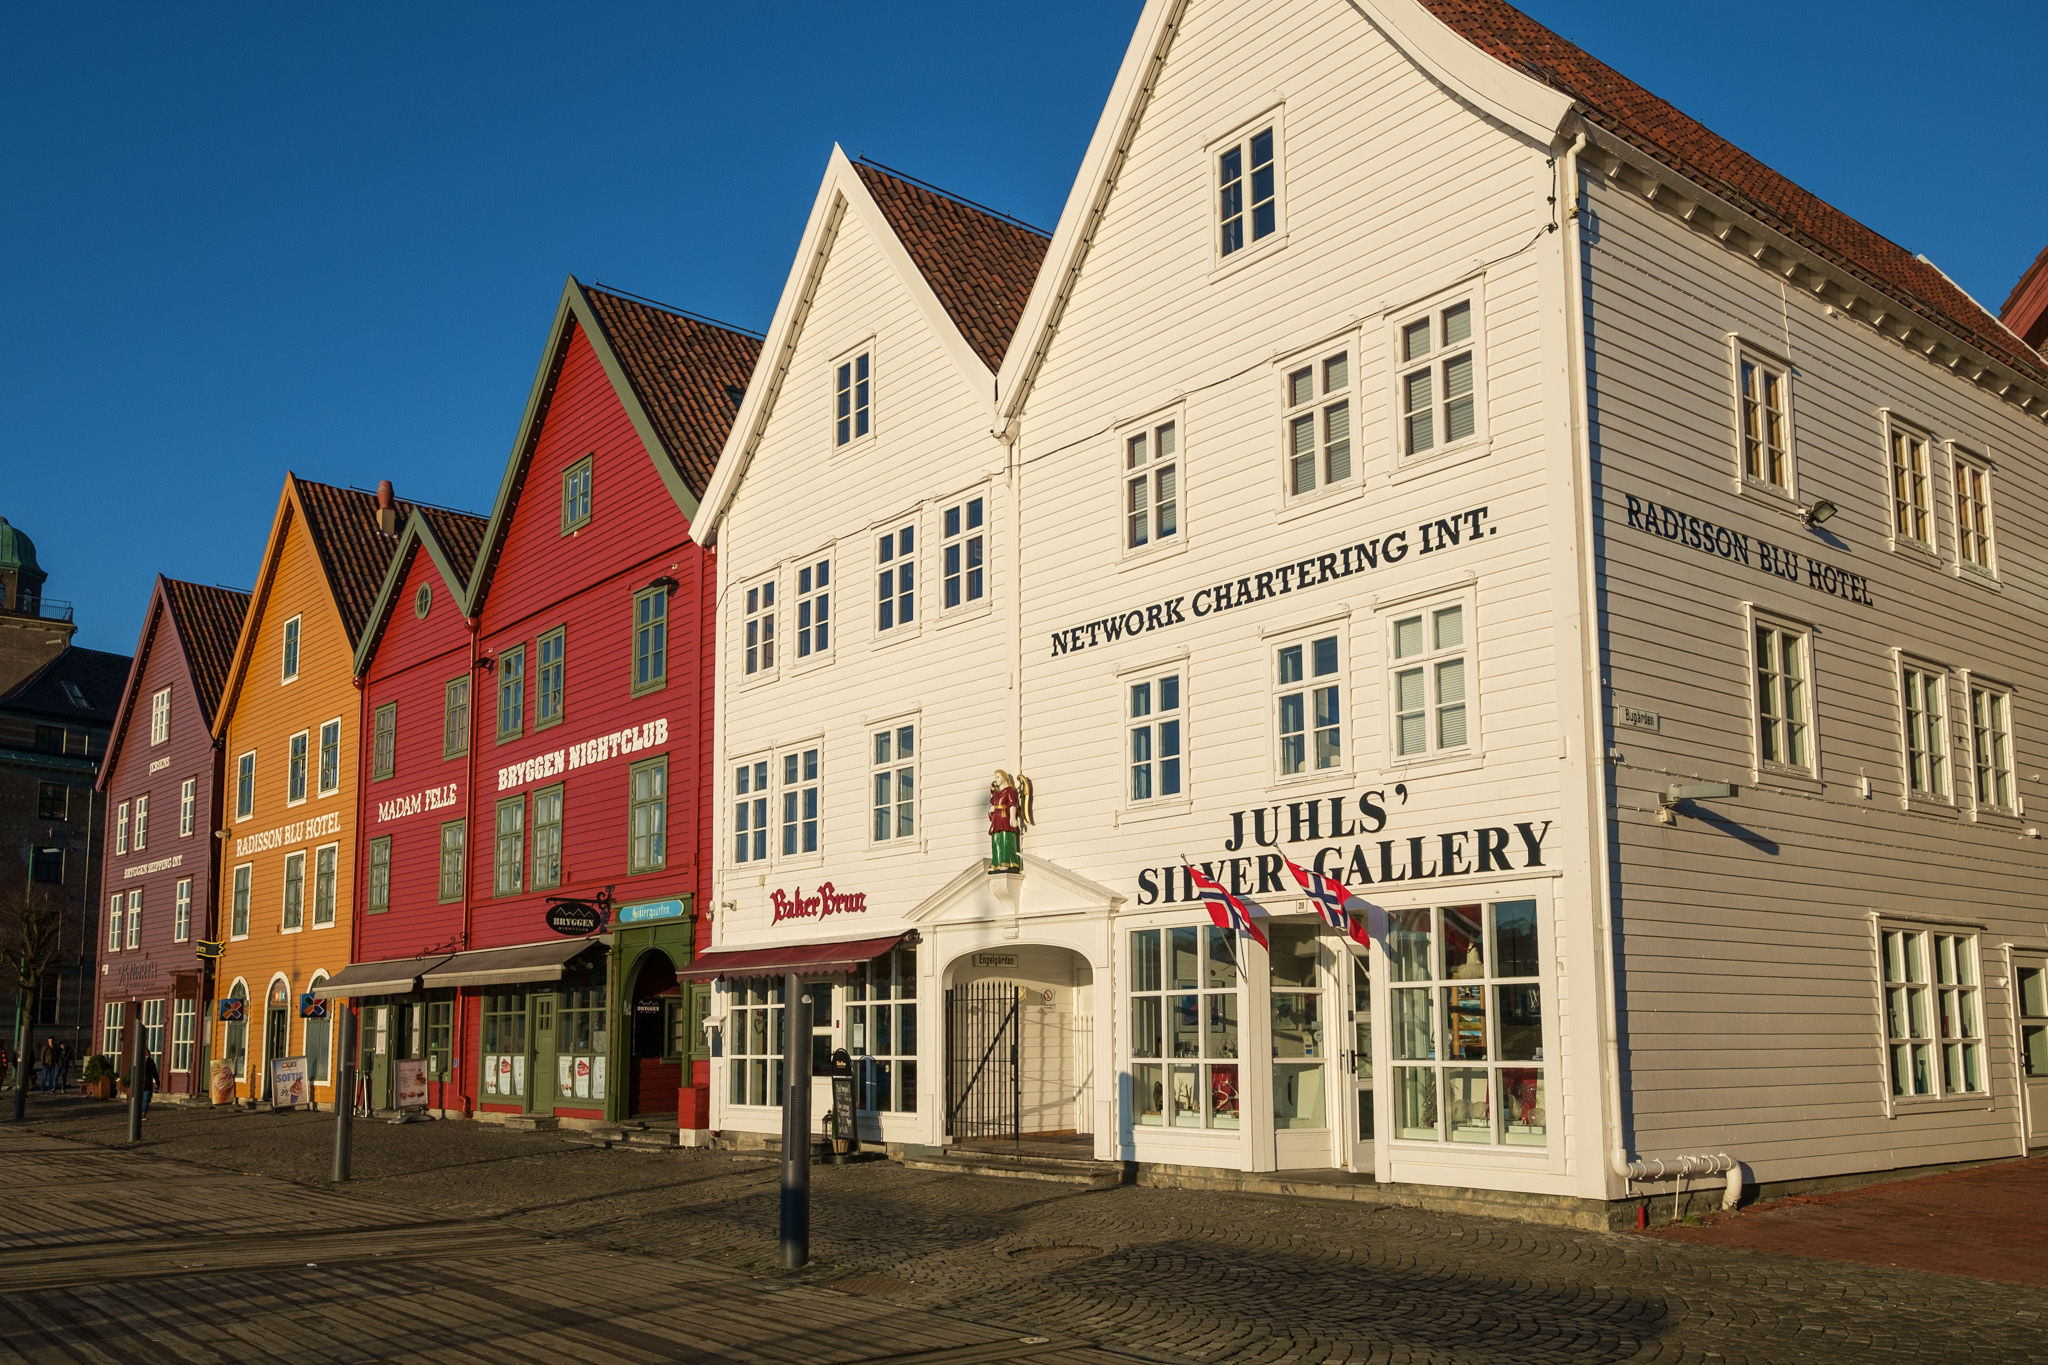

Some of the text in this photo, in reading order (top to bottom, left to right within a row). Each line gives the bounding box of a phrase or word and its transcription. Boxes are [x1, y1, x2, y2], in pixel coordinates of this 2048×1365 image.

[1625, 493, 1874, 607] RADISSON BLU HOTEL
[1050, 506, 1497, 657] NETWORK CHARTERING INT.
[1625, 708, 1655, 727] Bugården
[497, 717, 669, 791] BRYGGEN NIGHTCLUB
[377, 783, 458, 823] MADAM FELLE
[1224, 783, 1409, 852] JUHLS’
[235, 811, 341, 858] RADISSON BLU HOTEL
[1136, 820, 1553, 906] SILVER GALLERY
[552, 917, 595, 928] BRYGGEN
[769, 881, 867, 927] Baker Brun
[1297, 901, 1305, 910] 39
[978, 954, 1015, 967] Engelgården
[276, 1071, 304, 1083] SOFTIS
